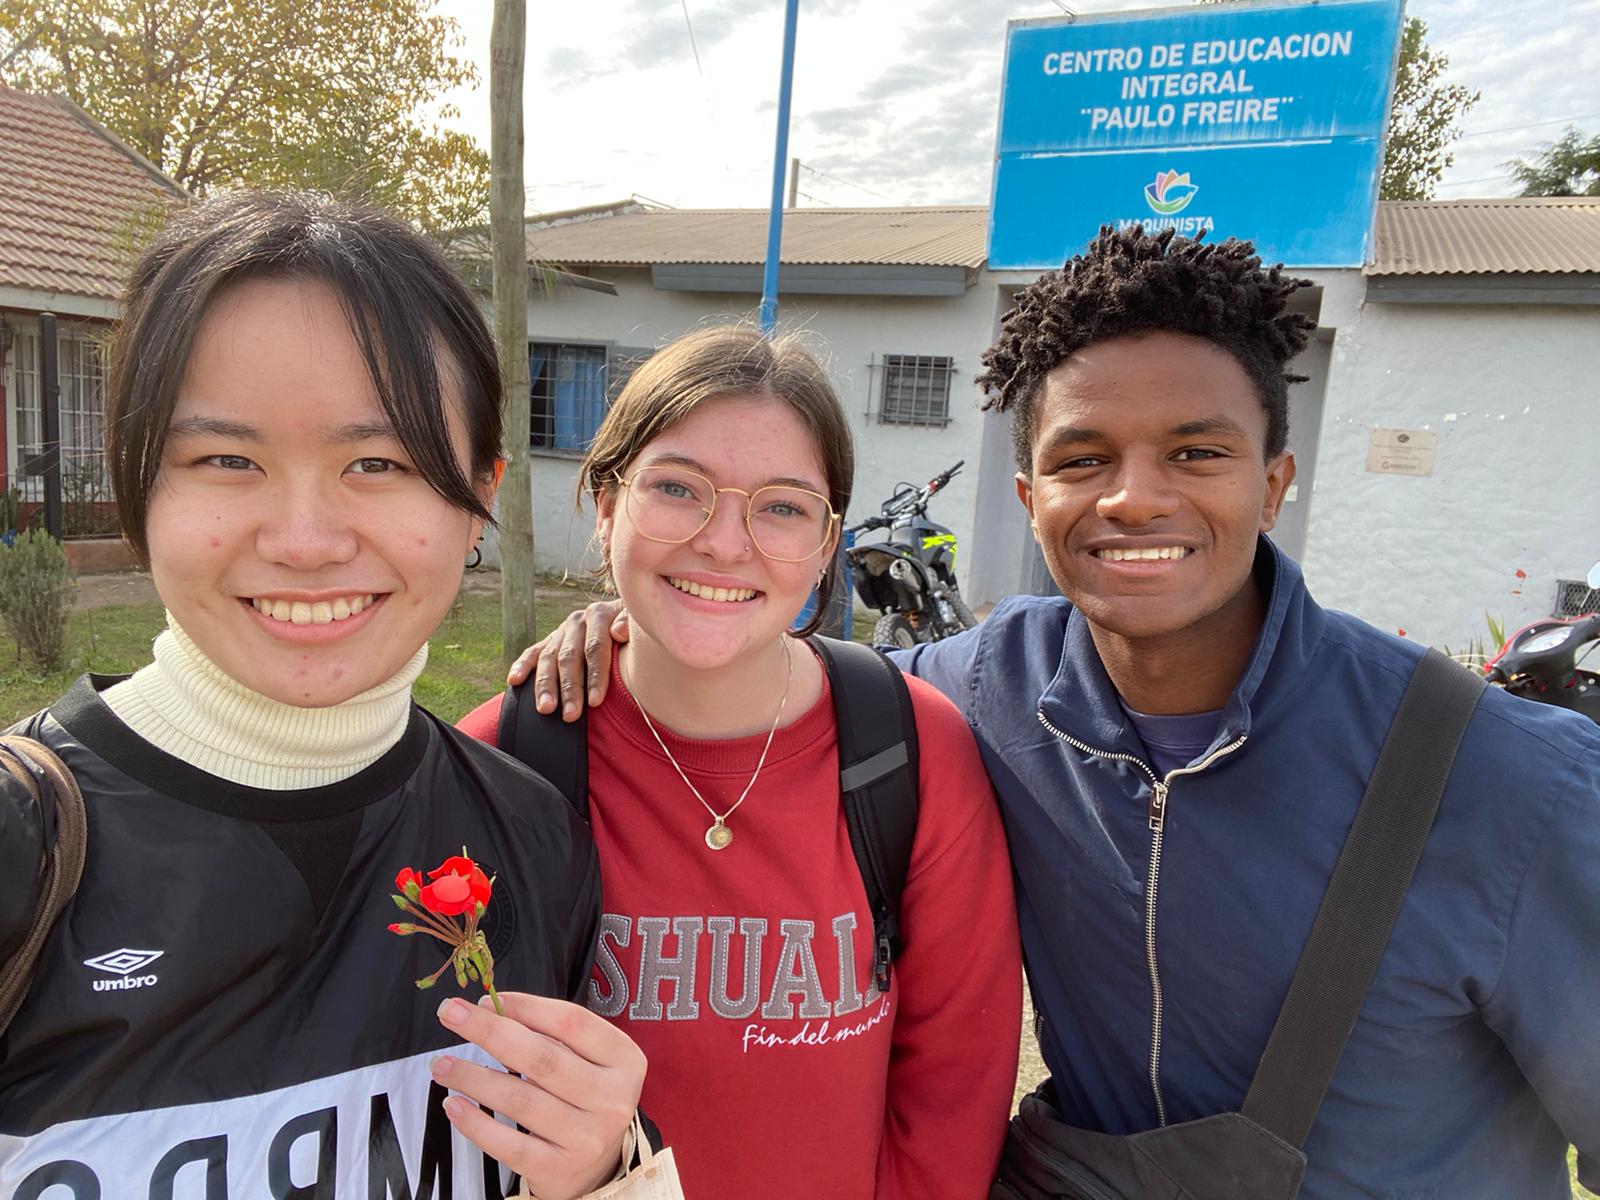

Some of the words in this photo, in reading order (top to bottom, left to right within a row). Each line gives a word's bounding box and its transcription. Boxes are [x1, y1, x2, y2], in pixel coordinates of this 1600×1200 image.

[1043, 46, 1143, 75] CENTRO
[1149, 43, 1185, 68] DE
[1191, 30, 1353, 65] EDUCACION
[1121, 69, 1254, 100] INTEGRAL
[587, 912, 882, 1021] SHUAI
[92, 974, 158, 992] umbro
[787, 1021, 830, 1045] del
